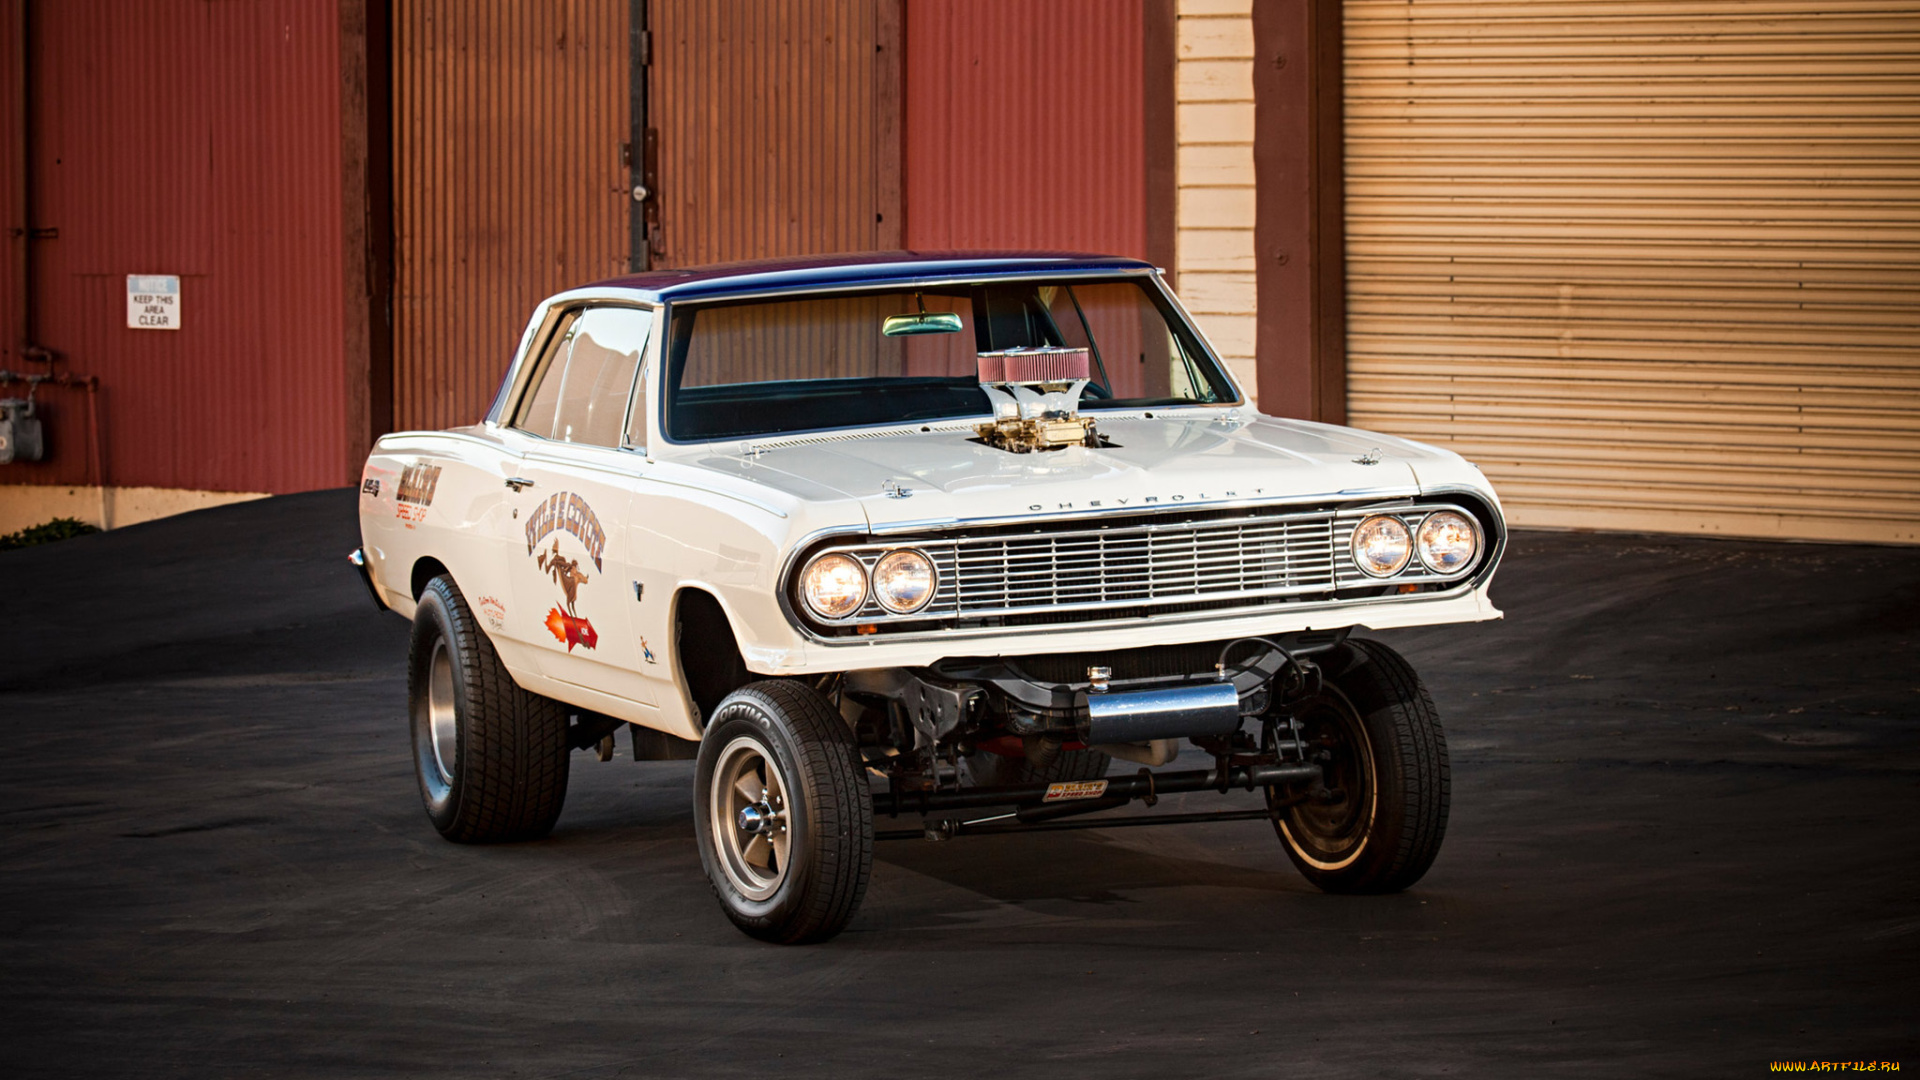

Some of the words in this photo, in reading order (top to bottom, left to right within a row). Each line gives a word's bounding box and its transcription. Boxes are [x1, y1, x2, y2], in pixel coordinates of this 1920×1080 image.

[133, 295, 153, 304] KEEP
[156, 295, 174, 305] THIS
[144, 305, 165, 314] AREA
[138, 315, 169, 326] CLEAR
[1029, 488, 1264, 511] CHEVROLET
[395, 503, 413, 520] SPEED
[411, 506, 427, 522] SHOP
[525, 493, 558, 557] WILE
[556, 491, 568, 530] E
[565, 492, 607, 575] COYOTE
[719, 704, 771, 731] OPTIMO
